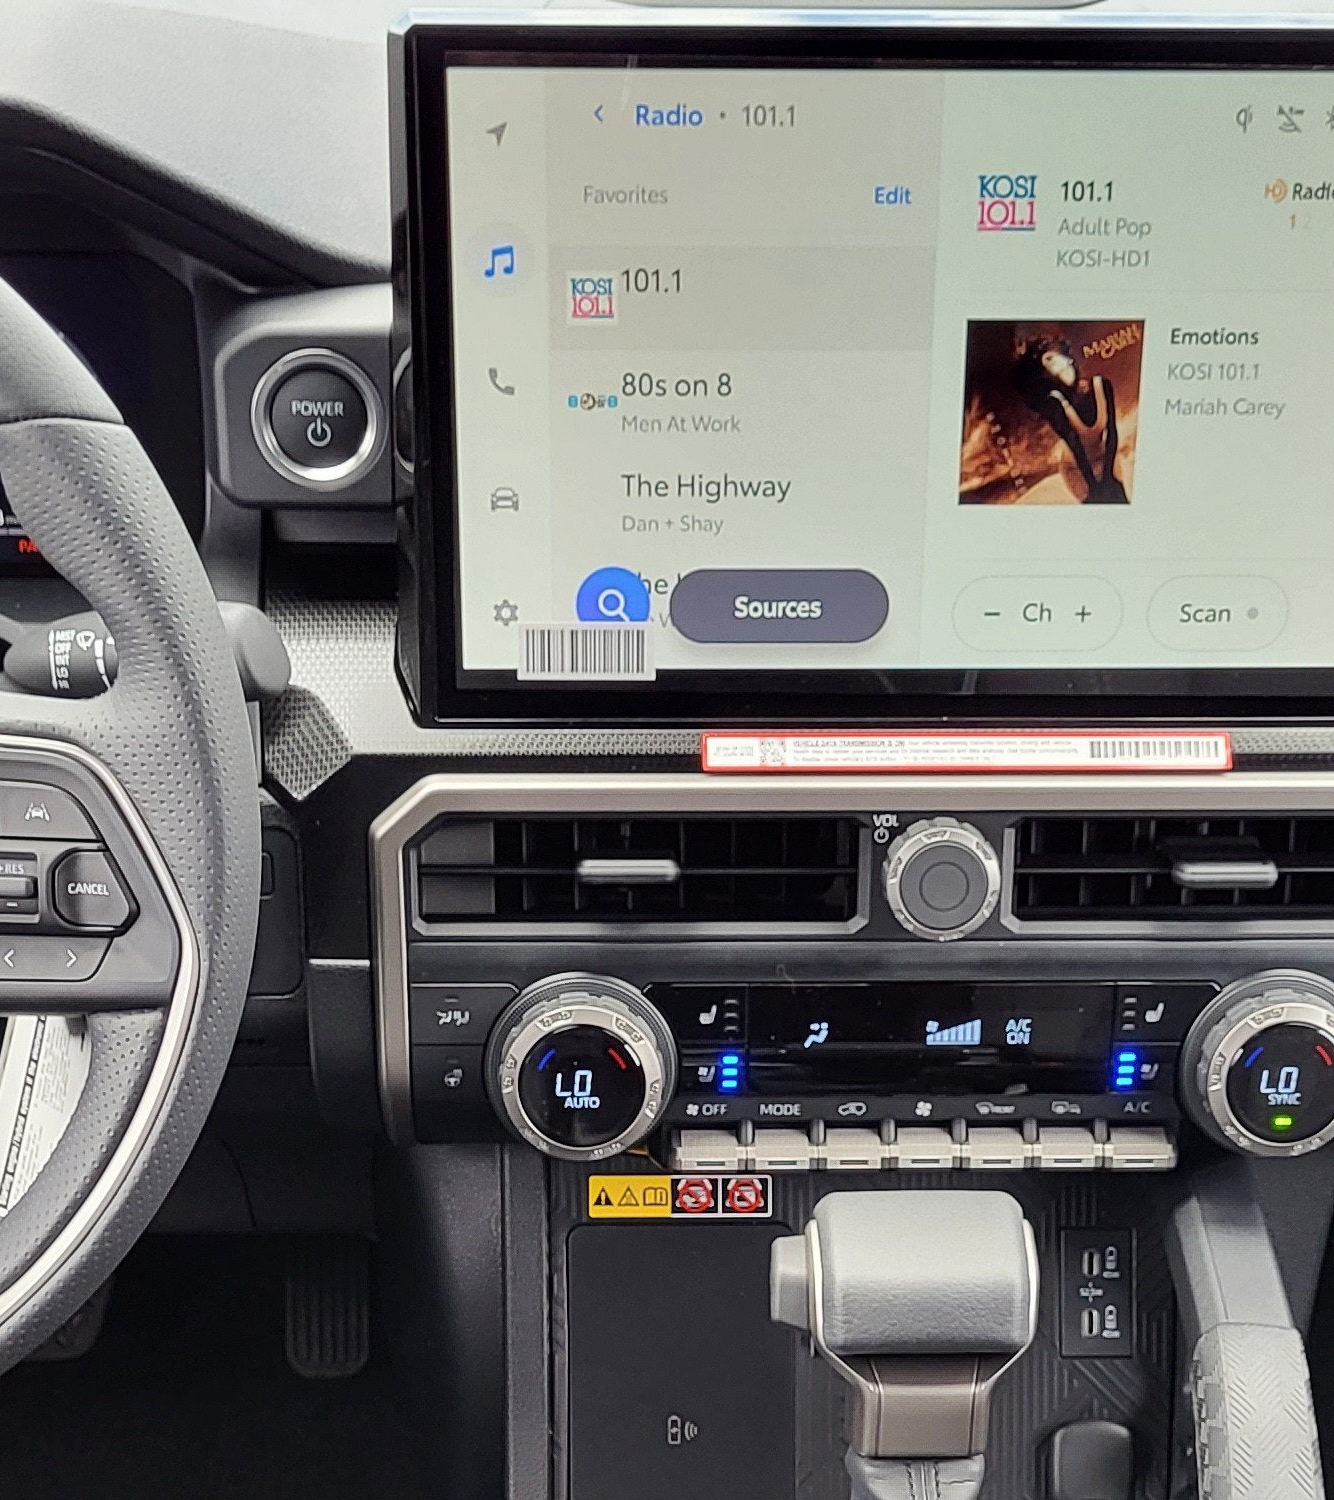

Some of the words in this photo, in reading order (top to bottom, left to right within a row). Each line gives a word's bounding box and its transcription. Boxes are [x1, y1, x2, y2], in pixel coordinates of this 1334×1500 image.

[635, 103, 703, 127] Radio
[741, 105, 797, 128] 101.1
[583, 185, 668, 204] Favorites
[874, 186, 912, 204] Edit
[978, 174, 1037, 199] KOSI
[1060, 181, 1114, 202] 101.1
[977, 200, 1037, 226] 101.1
[1057, 217, 1111, 238] Adult
[1115, 217, 1152, 240] Pop
[1056, 249, 1151, 269] KOSI-HD1
[570, 277, 613, 296] KOSI
[621, 268, 682, 293] 101.1
[1170, 327, 1260, 346] Emotions
[1167, 362, 1213, 382] KOSI
[1218, 362, 1261, 381] 101.1
[621, 373, 667, 397] 80s
[674, 378, 708, 397] on
[716, 373, 733, 397] 8
[290, 400, 345, 417] POWER
[1164, 398, 1227, 417] Mariah
[1232, 399, 1286, 420] Carey
[621, 416, 662, 434] Men
[667, 415, 688, 434] At
[691, 415, 741, 434] Work
[621, 473, 668, 498] The
[676, 473, 792, 503] Highway
[621, 515, 660, 534] Dan
[679, 515, 724, 537] Shay
[733, 596, 822, 620] Sources
[1022, 604, 1052, 623] Ch
[1179, 604, 1231, 623] Scan
[872, 814, 899, 828] VOL
[67, 882, 110, 897] CANCEL
[1005, 1018, 1033, 1033] A/C
[1006, 1031, 1031, 1045] ON
[555, 1069, 593, 1097] LO
[1259, 1066, 1300, 1095] LO
[564, 1096, 600, 1109] AUTO
[1123, 1101, 1152, 1114] A/C
[1268, 1093, 1302, 1106] SYNC
[701, 1103, 728, 1116] OFF
[759, 1103, 802, 1116] MODE
